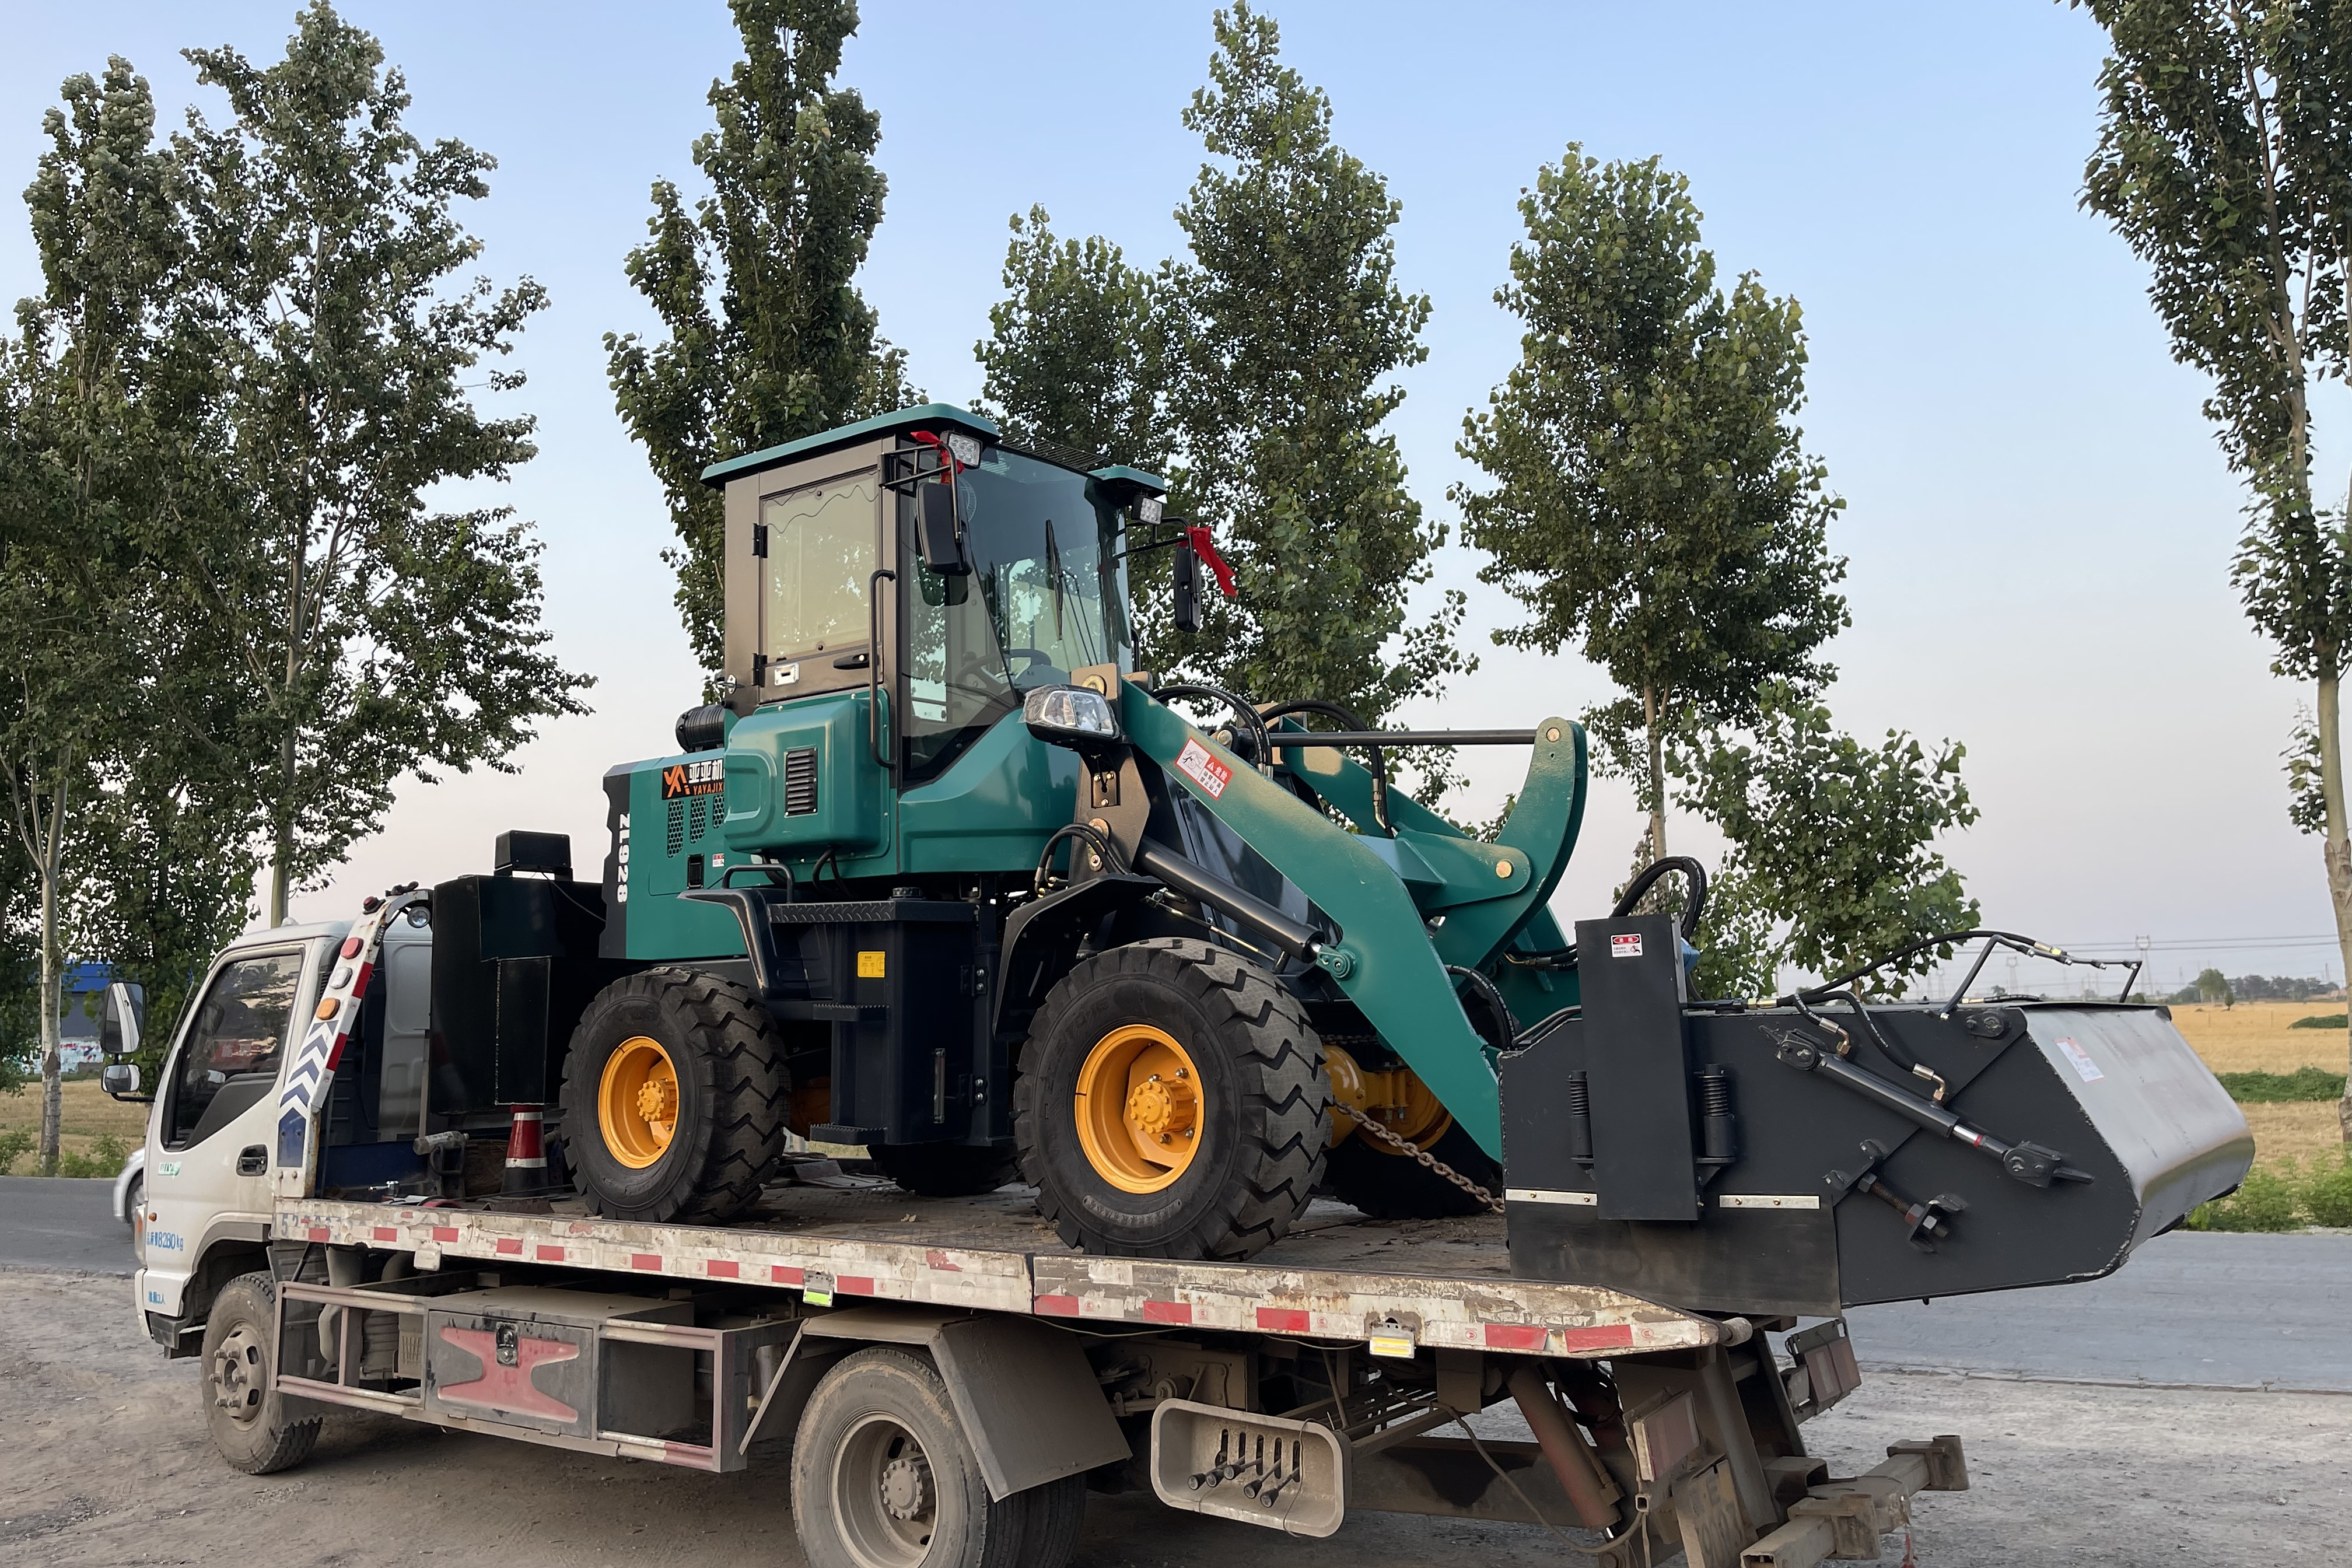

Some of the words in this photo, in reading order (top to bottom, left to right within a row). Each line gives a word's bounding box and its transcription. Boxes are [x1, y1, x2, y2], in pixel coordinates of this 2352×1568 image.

[688, 759, 725, 784] 亚亚机
[1214, 766, 1228, 781] 危险
[617, 813, 631, 903] ZL928
